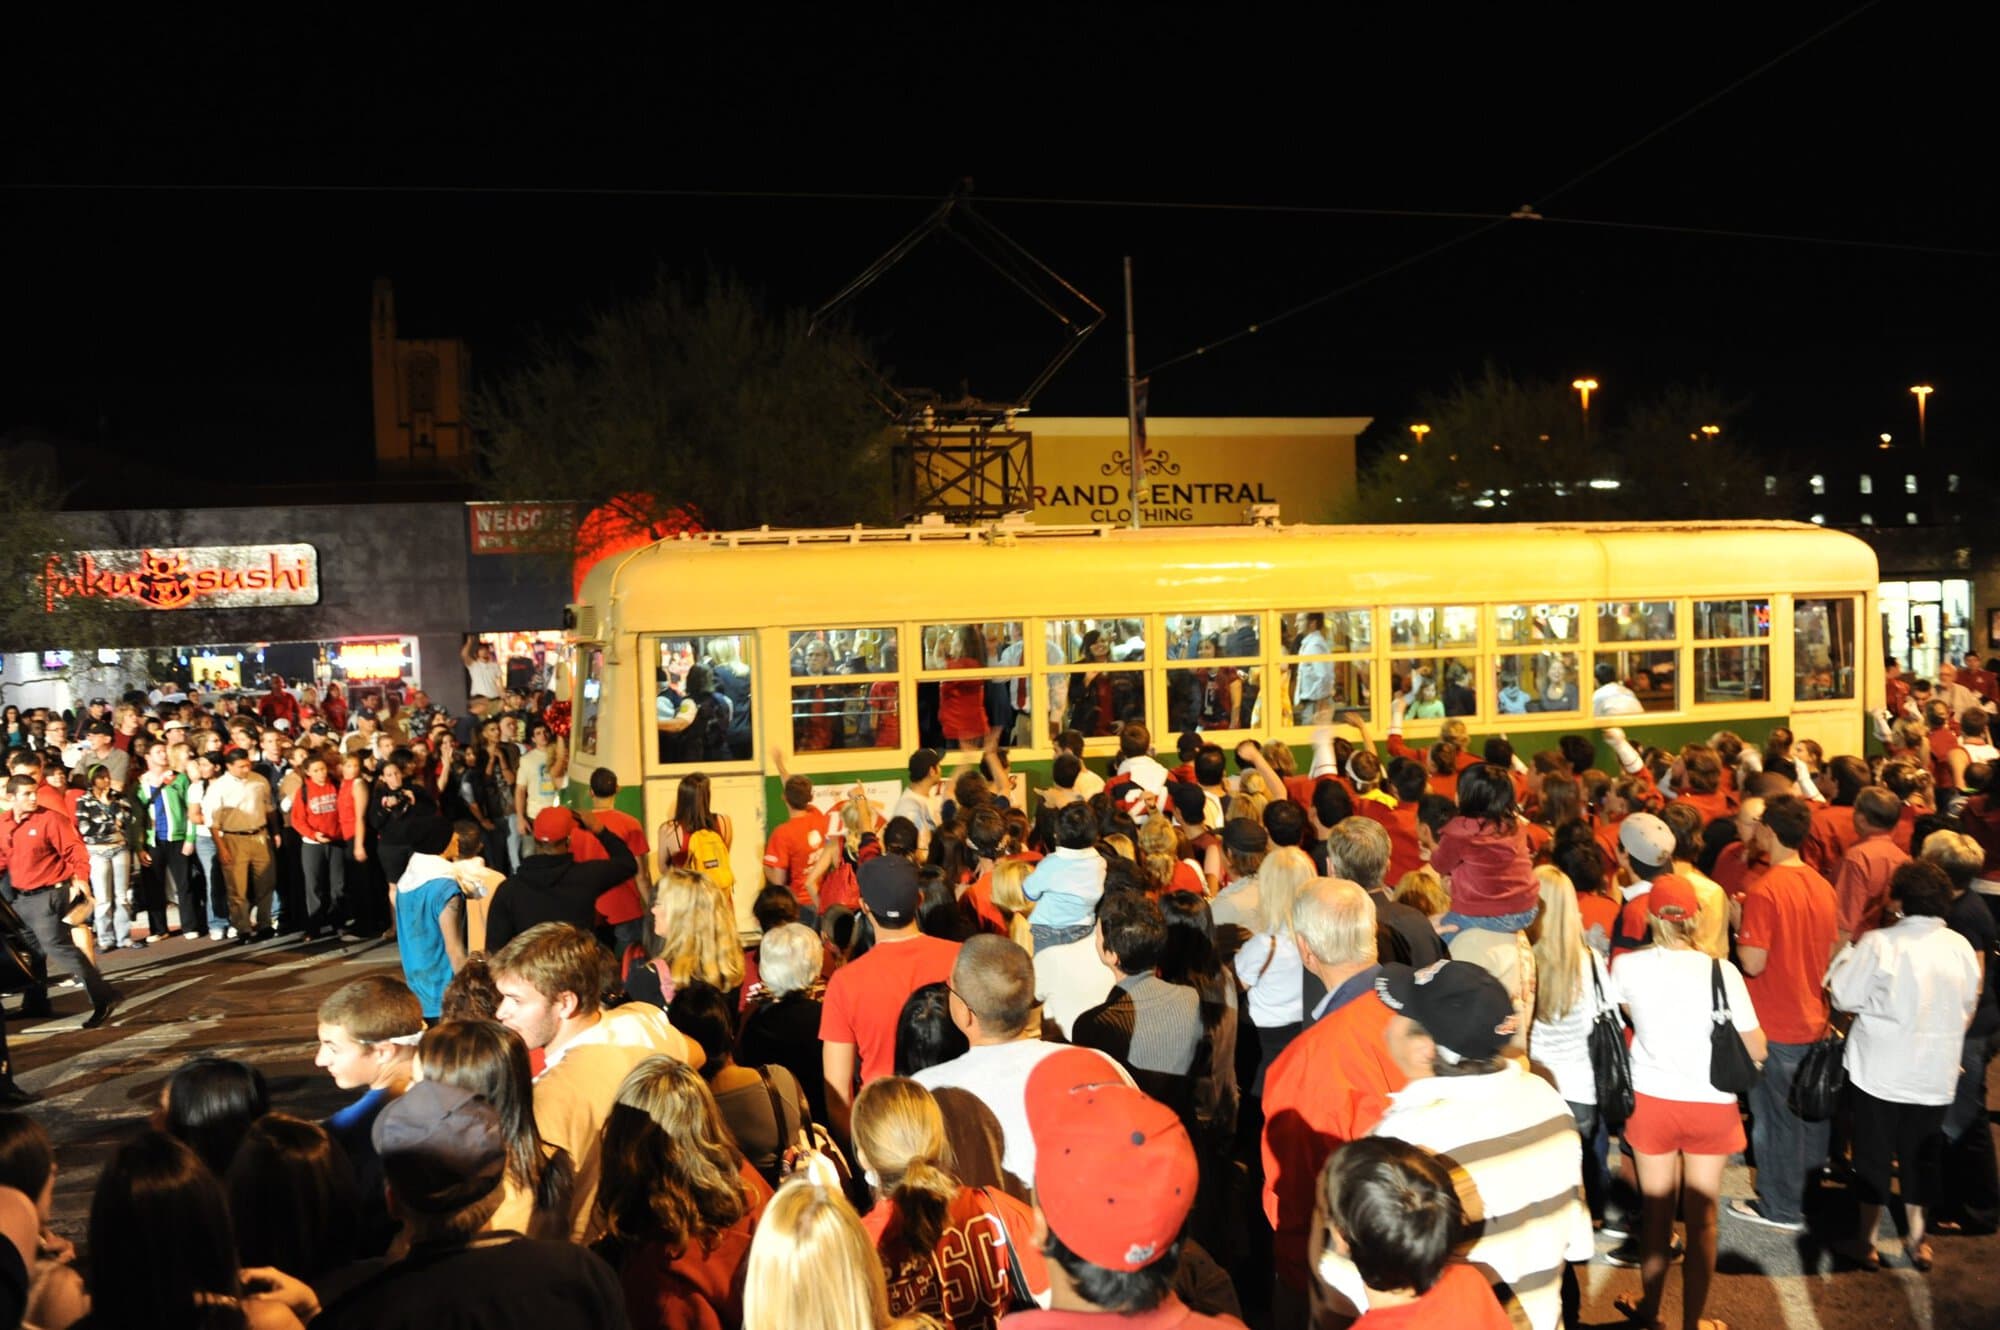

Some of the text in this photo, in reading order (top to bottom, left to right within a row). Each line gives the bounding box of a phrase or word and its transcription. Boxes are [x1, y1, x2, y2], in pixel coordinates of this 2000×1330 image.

[476, 509, 573, 532] WELCOE
[1090, 507, 1194, 522] CLOHING
[36, 552, 307, 612] fuku sushi
